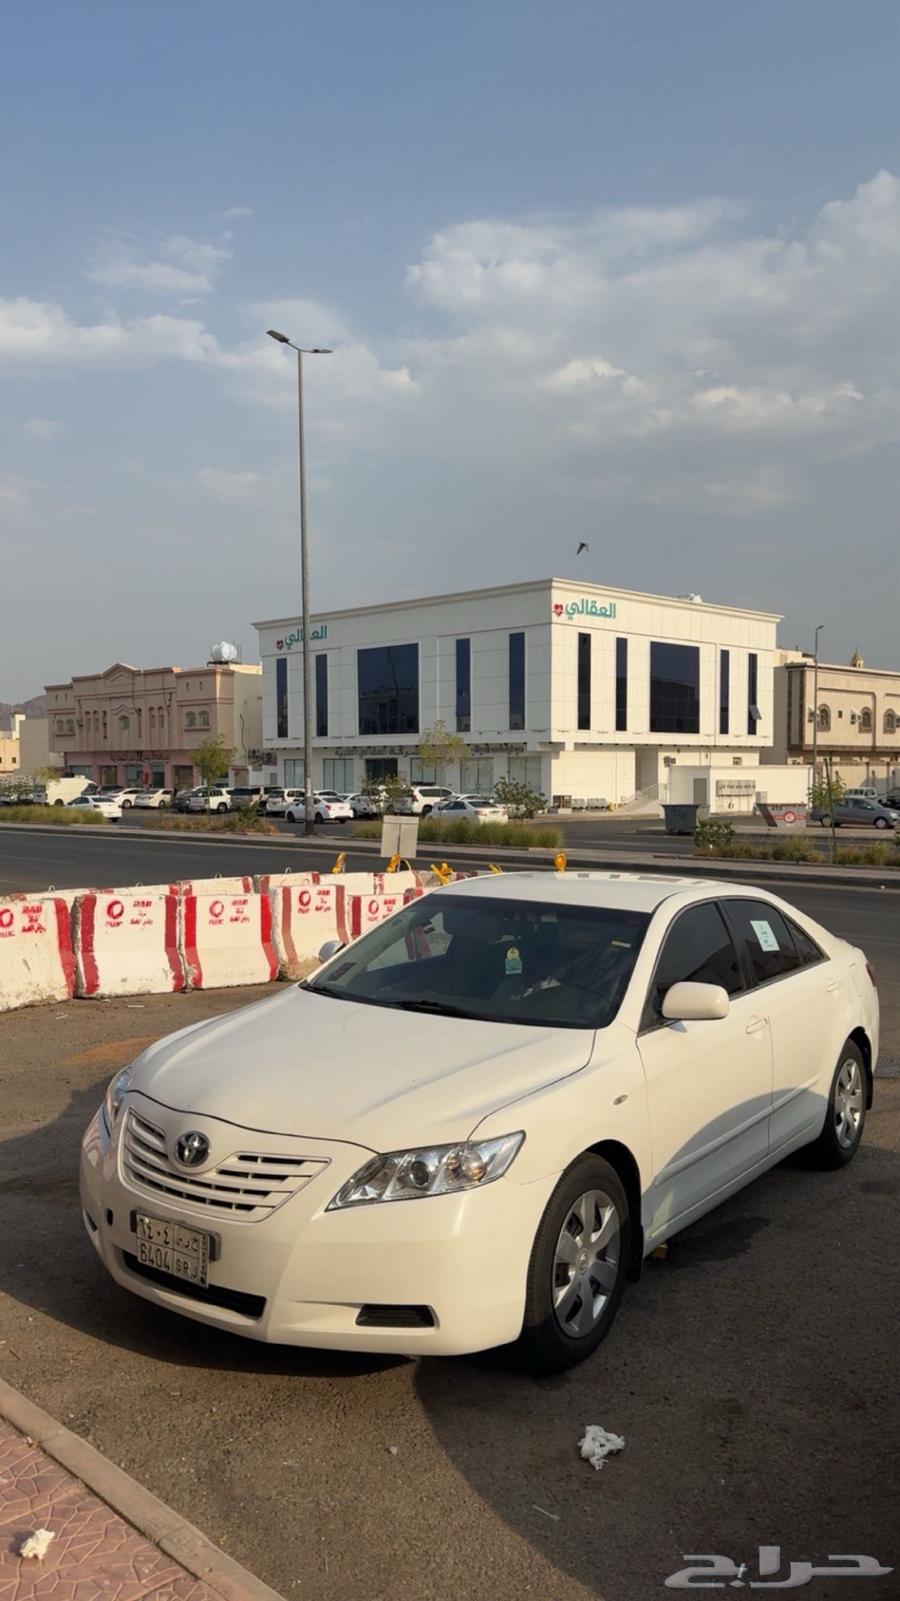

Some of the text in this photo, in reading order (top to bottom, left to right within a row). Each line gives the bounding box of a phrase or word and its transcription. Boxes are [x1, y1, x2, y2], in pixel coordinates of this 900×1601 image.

[565, 598, 616, 621] العقالي
[284, 624, 327, 650] العالي
[140, 1243, 170, 1271] 6404
[175, 1258, 198, 1279] SRJ
